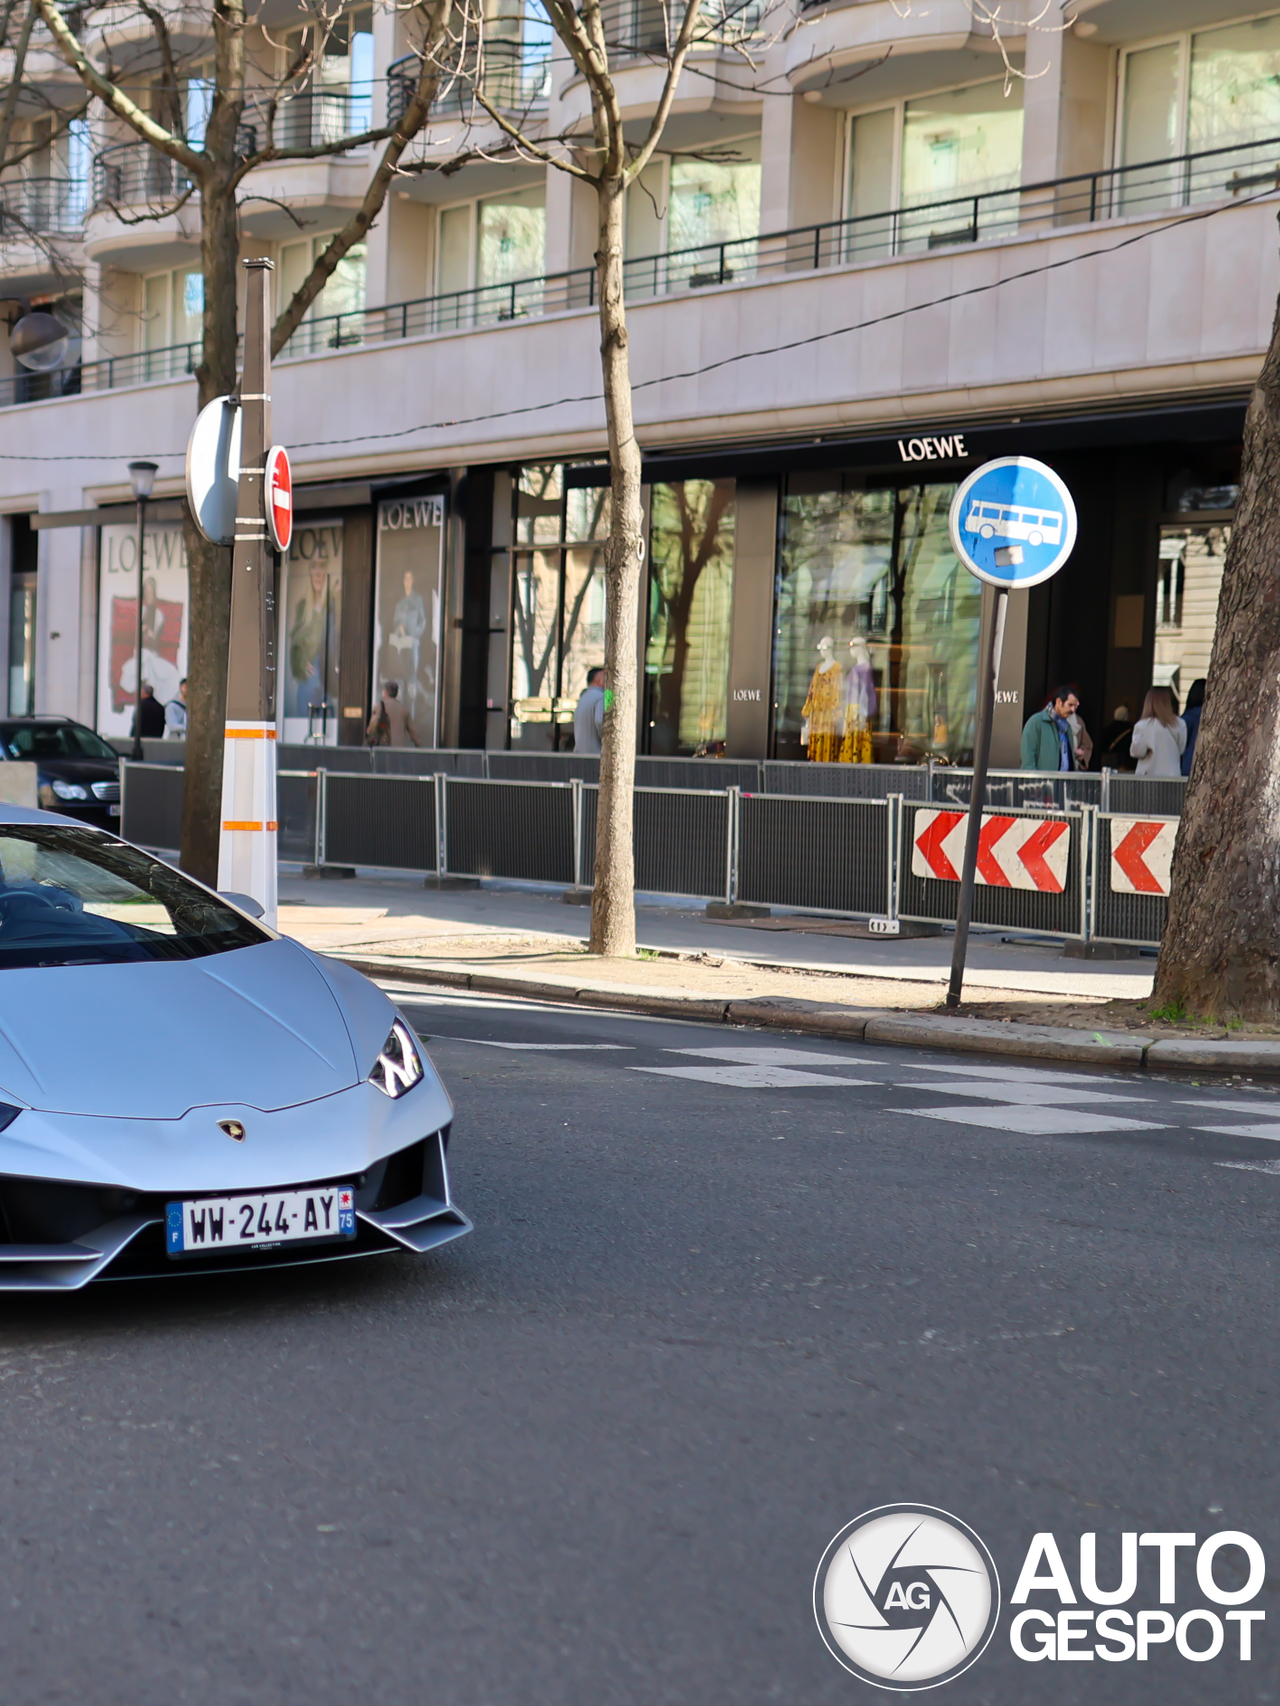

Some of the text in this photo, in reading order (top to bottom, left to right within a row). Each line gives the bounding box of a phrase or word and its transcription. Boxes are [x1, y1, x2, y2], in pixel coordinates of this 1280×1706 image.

[898, 434, 969, 462] LOEWE
[380, 500, 442, 532] LOEWE
[733, 689, 762, 702] LOEWE
[190, 1195, 333, 1243] WW-244-AY
[340, 1213, 353, 1228] 75
[172, 1232, 179, 1243] F
